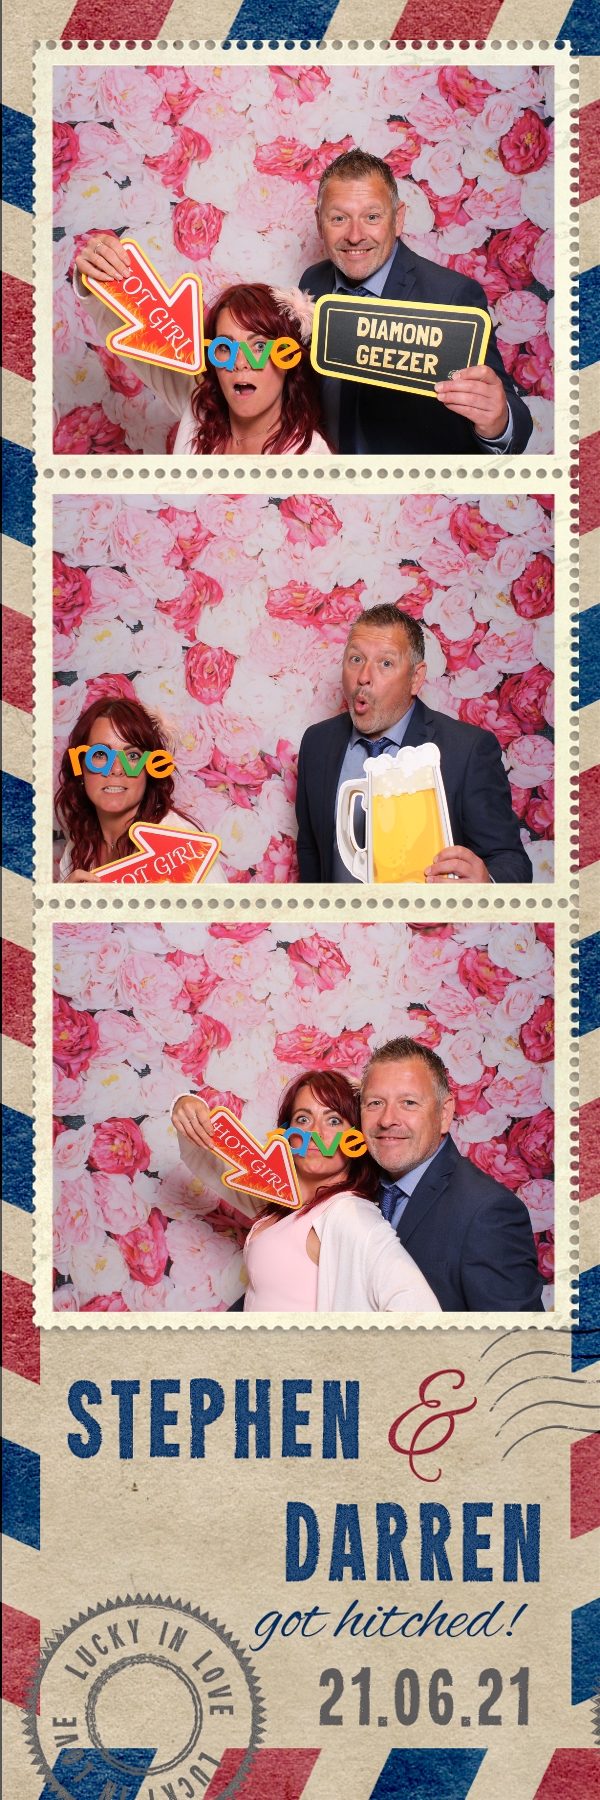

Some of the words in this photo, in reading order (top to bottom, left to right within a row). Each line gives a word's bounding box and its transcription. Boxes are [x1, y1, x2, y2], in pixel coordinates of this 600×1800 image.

[118, 267, 157, 307] OT
[149, 307, 192, 360] GIRL
[356, 316, 443, 348] DIAMOND
[204, 336, 302, 372] ave
[356, 344, 439, 376] GEEZER
[68, 744, 175, 779] rave
[112, 863, 151, 883] OT
[153, 841, 205, 876] GIRL
[213, 1122, 254, 1158] HOT
[250, 1159, 289, 1198] GIRL
